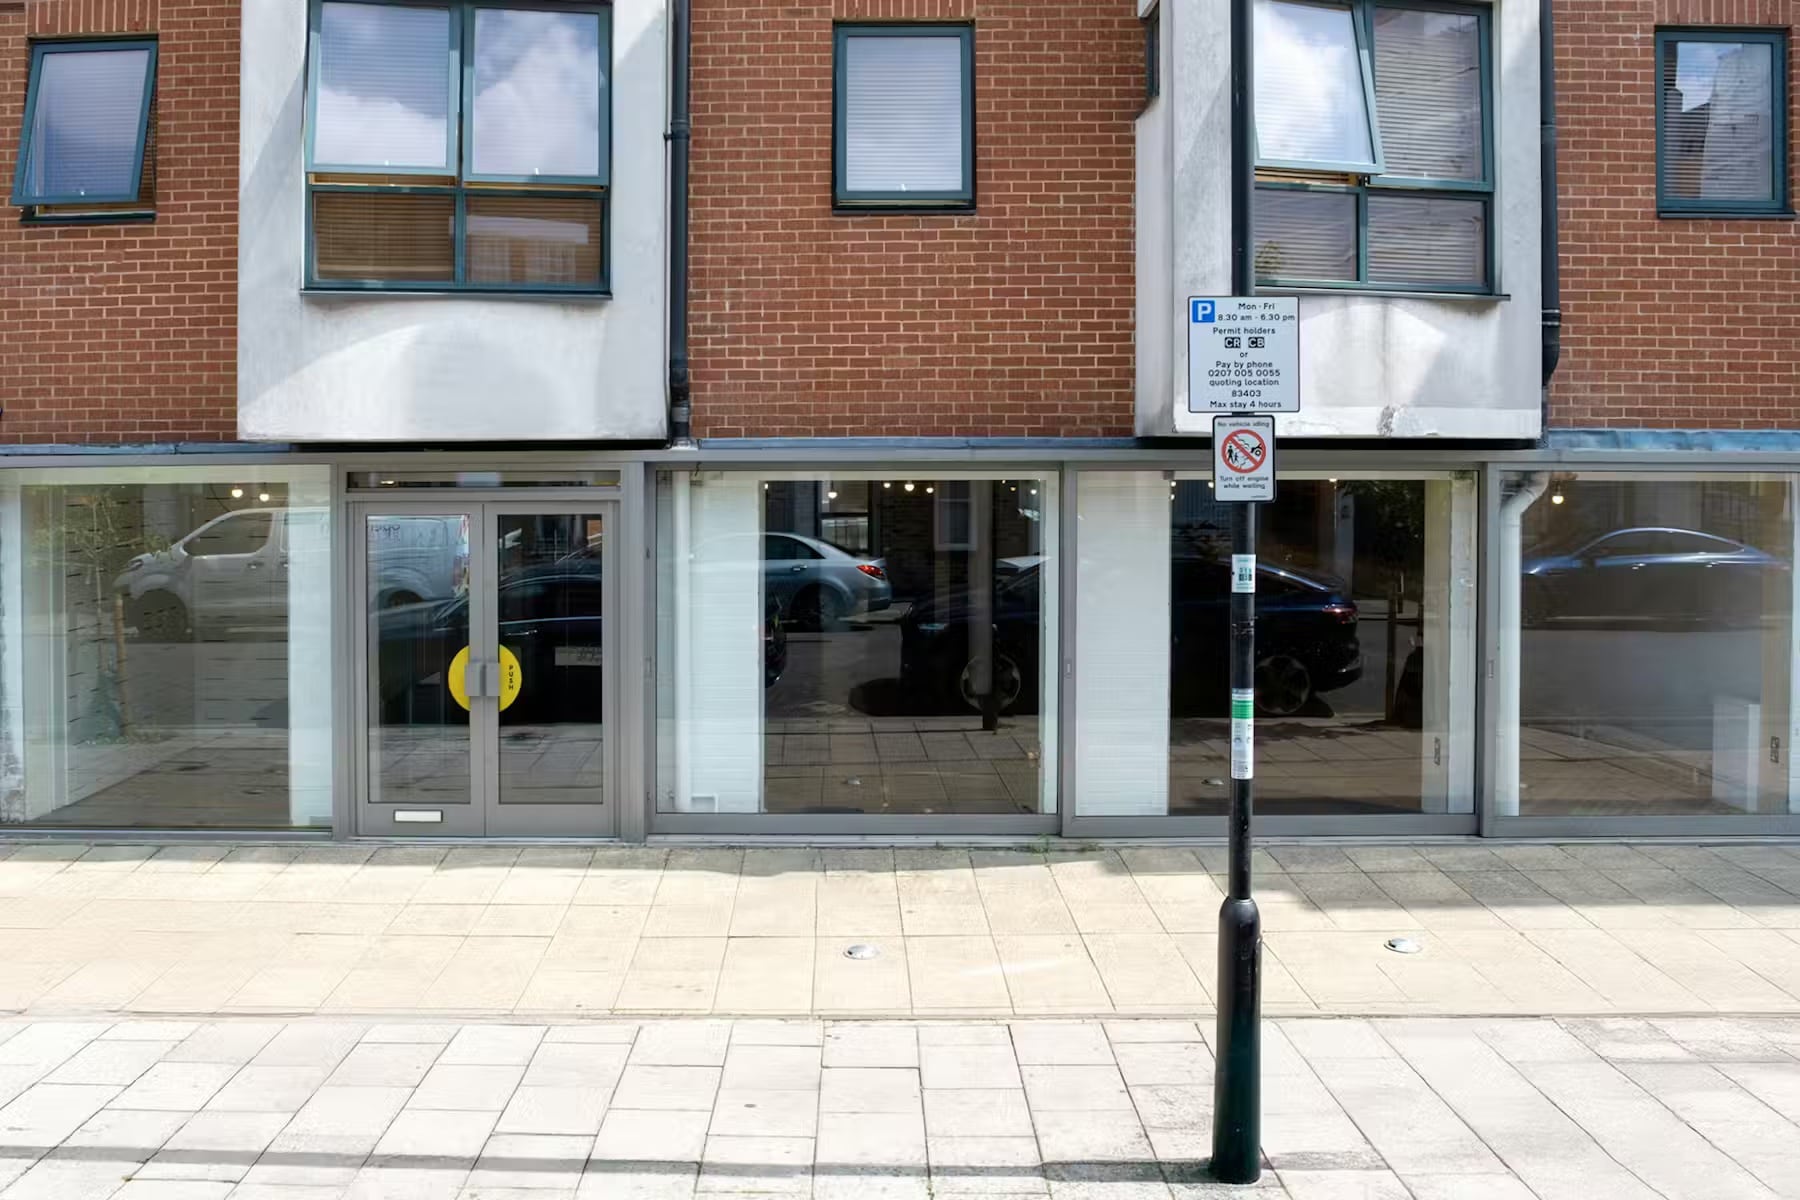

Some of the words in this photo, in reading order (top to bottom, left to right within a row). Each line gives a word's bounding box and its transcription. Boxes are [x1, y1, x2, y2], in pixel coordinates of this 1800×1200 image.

[1197, 303, 1212, 321] P
[1225, 338, 1240, 347] CR
[1248, 338, 1264, 347] CB
[1234, 361, 1244, 369] by
[1209, 379, 1242, 387] quoting
